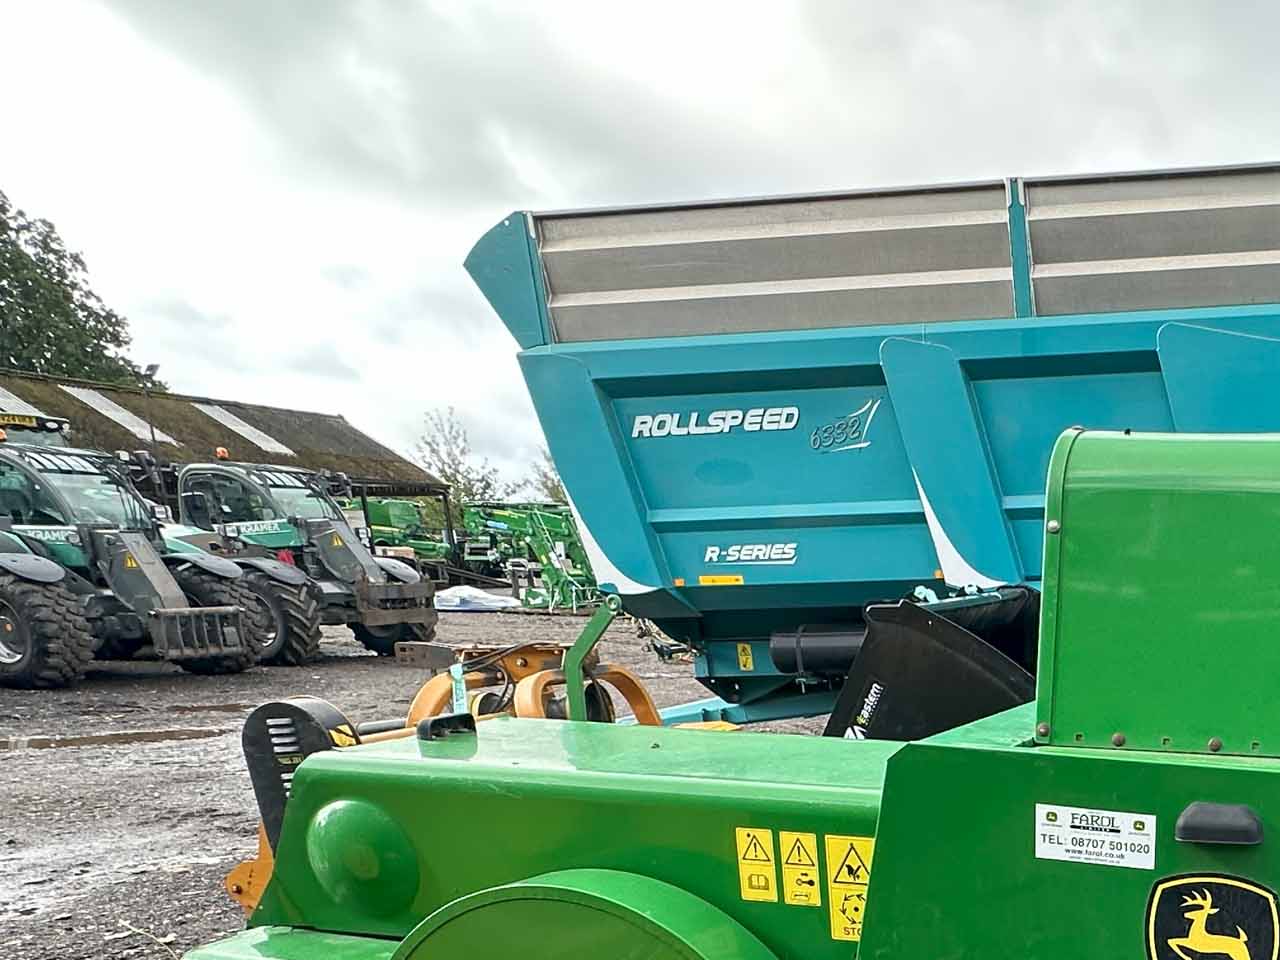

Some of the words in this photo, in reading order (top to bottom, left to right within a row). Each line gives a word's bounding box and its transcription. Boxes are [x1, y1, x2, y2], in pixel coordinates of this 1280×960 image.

[631, 406, 799, 438] ROLLSPEED
[809, 416, 862, 449] 6332
[704, 543, 797, 563] R-SERIES
[1070, 813, 1120, 828] FAROL
[1064, 848, 1125, 859] www.farol.co.uk
[1071, 836, 1106, 849] 08707
[1109, 840, 1150, 854] 501020
